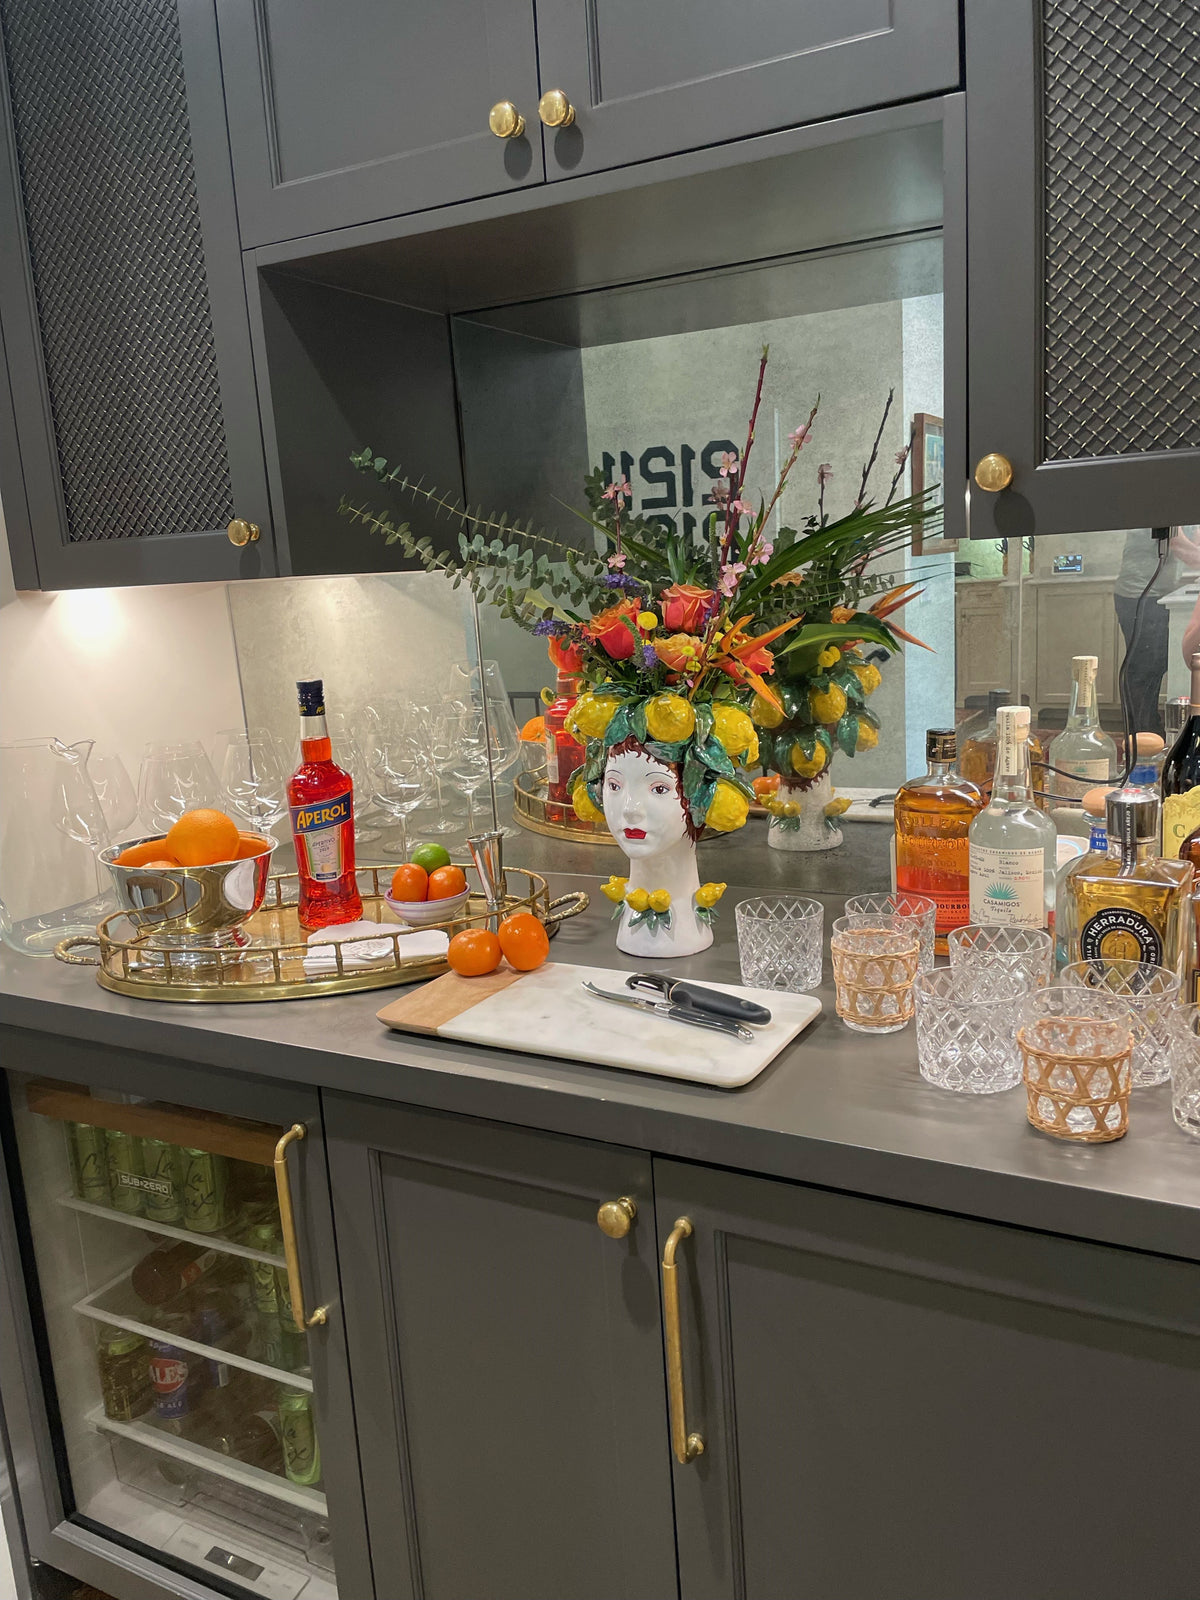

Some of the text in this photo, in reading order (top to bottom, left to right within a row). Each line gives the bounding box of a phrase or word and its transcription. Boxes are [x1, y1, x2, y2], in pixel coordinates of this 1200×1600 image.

[296, 802, 347, 830] APEROL
[983, 898, 1020, 908] CASAMIGOS
[990, 906, 1012, 914] Tequila
[1087, 915, 1153, 944] HERRADURA
